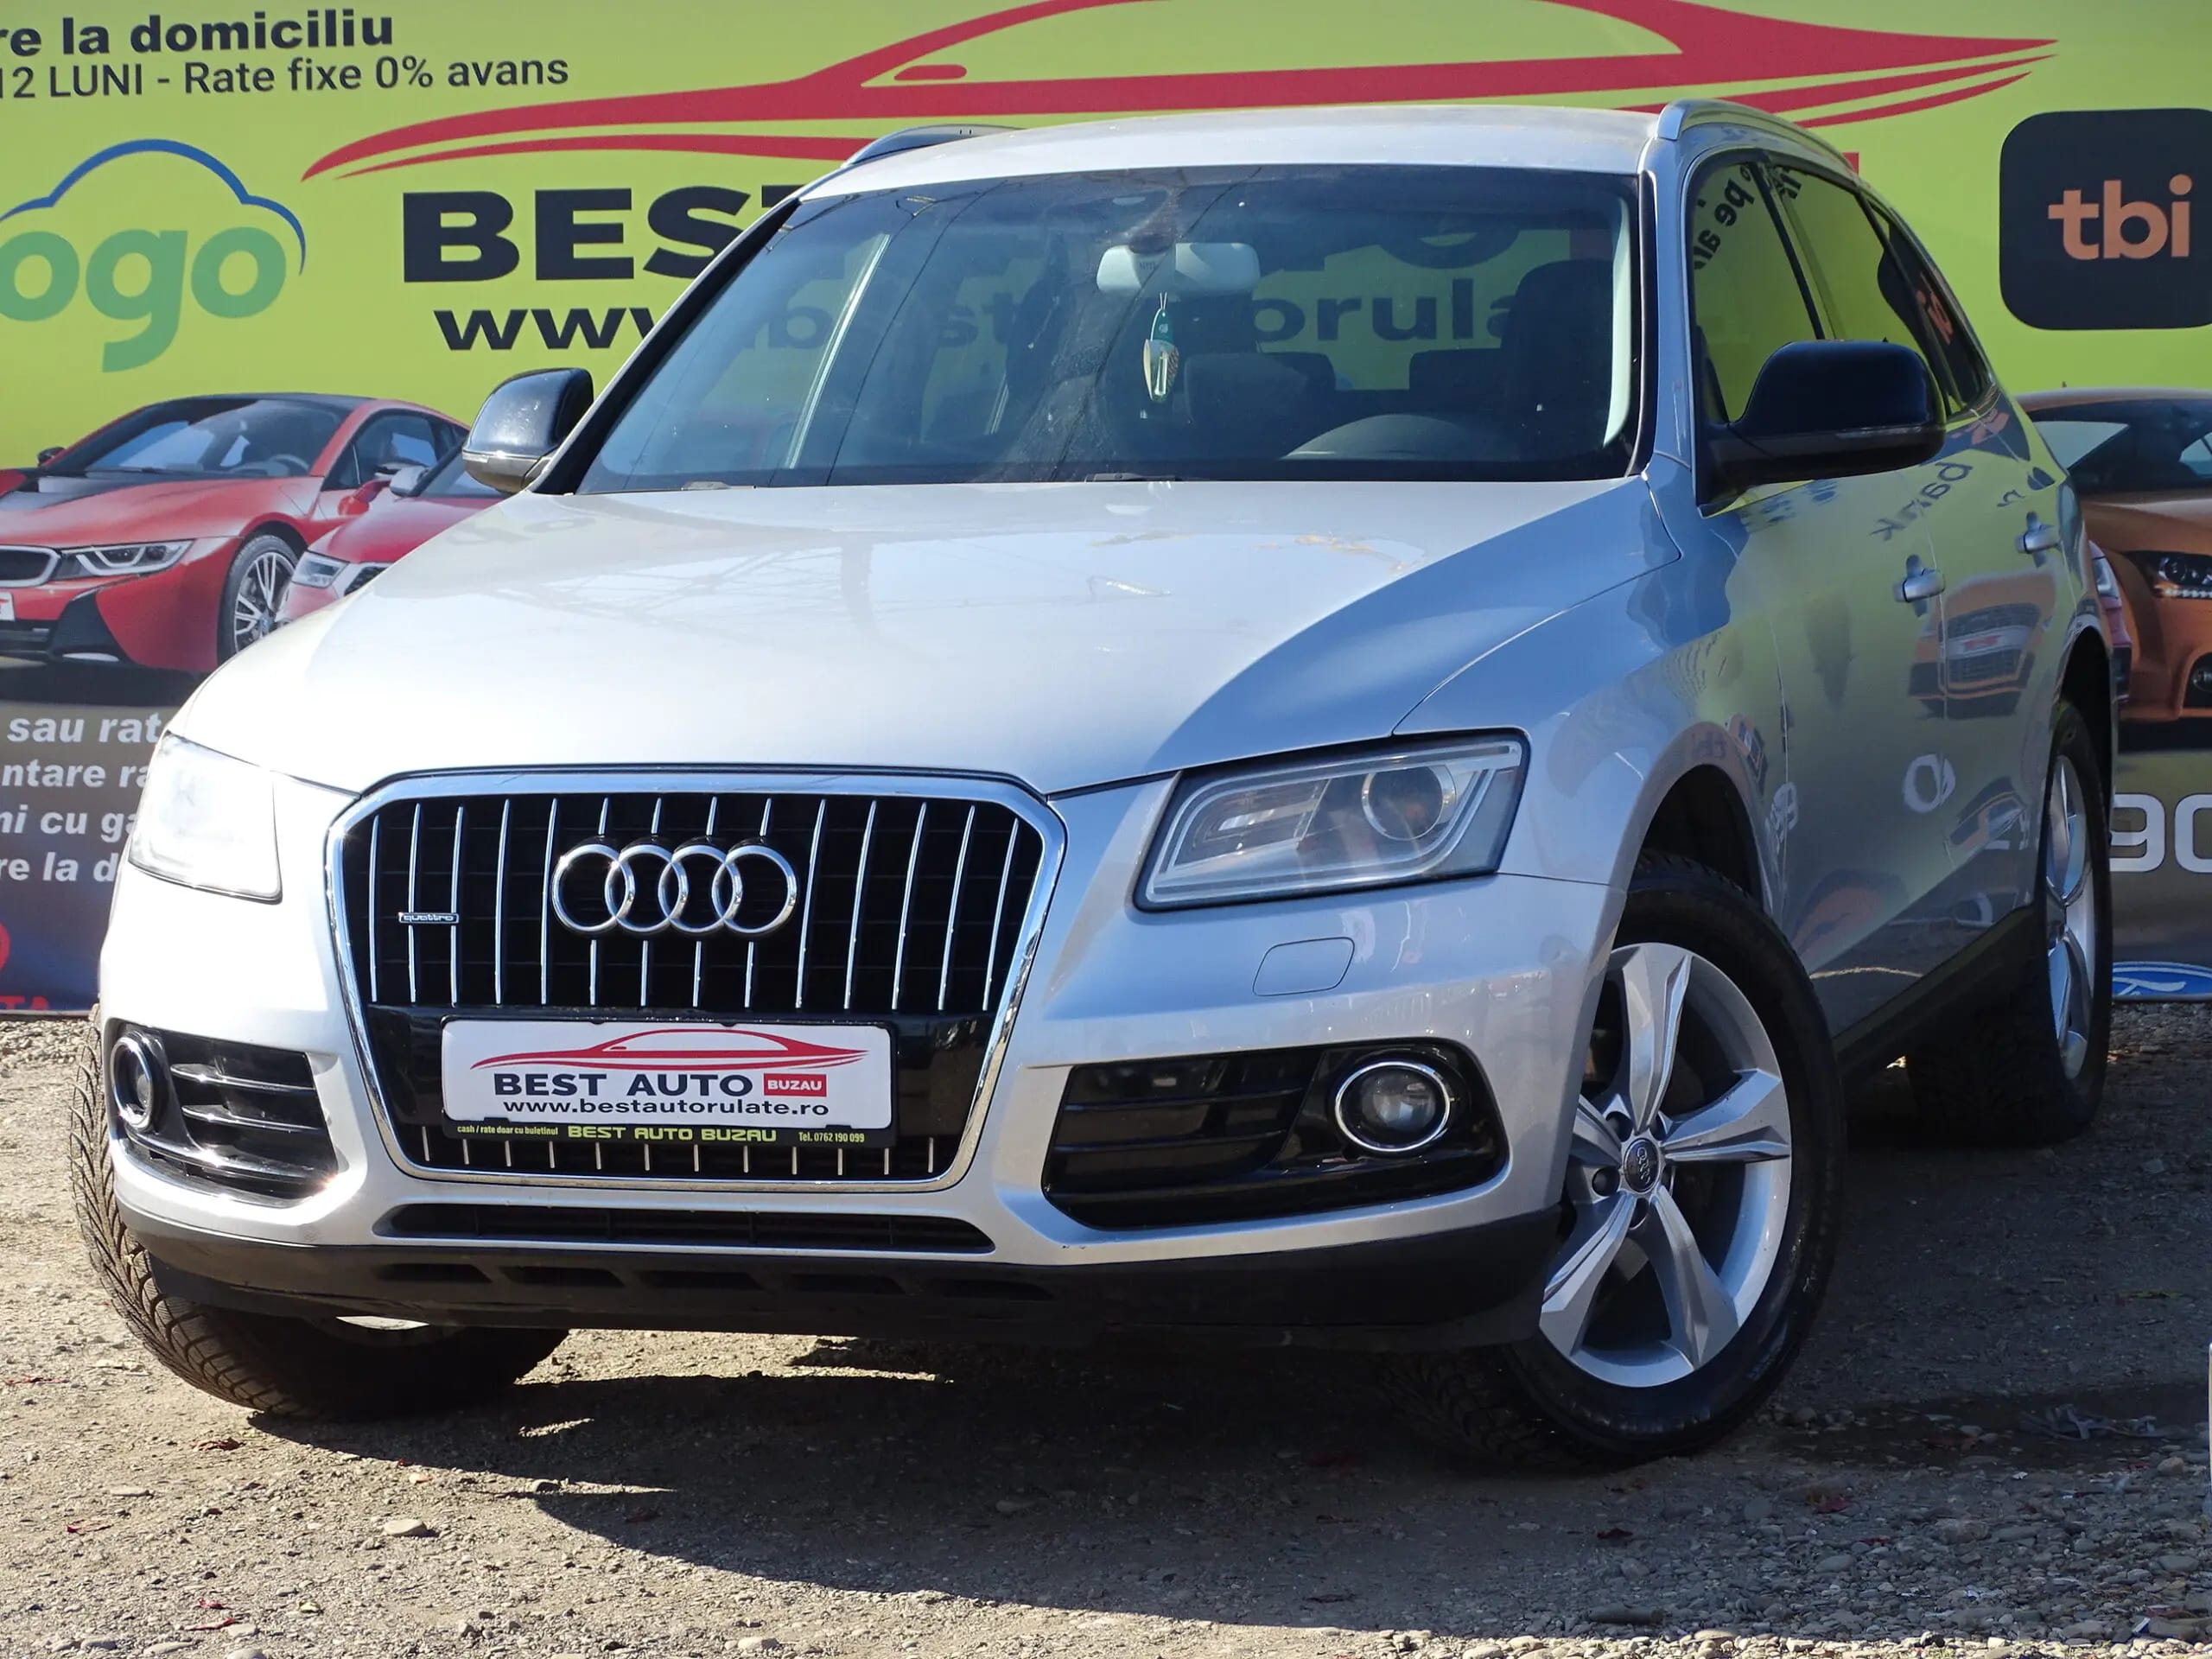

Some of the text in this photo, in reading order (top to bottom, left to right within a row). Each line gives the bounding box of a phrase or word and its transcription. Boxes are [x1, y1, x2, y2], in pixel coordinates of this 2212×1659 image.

[62, 16, 111, 55] la
[130, 9, 393, 54] domiciliu
[49, 63, 143, 97] LUNI
[184, 61, 275, 94] Rate
[288, 56, 362, 91] fixe
[375, 54, 434, 89] 0%
[447, 59, 569, 87] avans
[2048, 174, 2193, 260] tbi
[404, 185, 804, 283] BES
[7, 717, 85, 743] sau
[1, 759, 106, 788] ntare
[40, 811, 88, 835] cu
[42, 851, 79, 882] la
[404, 913, 454, 923] quattro
[493, 1073, 823, 1097] BEST AUTO BUZAU
[503, 1098, 830, 1116] www.bestautorulate.ro
[457, 1125, 475, 1134] cash
[480, 1126, 496, 1135] rate
[496, 1126, 513, 1135] doar
[524, 1126, 559, 1135] buletinul
[567, 1125, 626, 1140] BEST
[633, 1127, 693, 1141] AUTO
[700, 1128, 777, 1142] BUZAU
[798, 1131, 812, 1141] Tel.
[813, 1132, 833, 1142] 0762
[834, 1132, 849, 1142] 190
[849, 1133, 865, 1143] 099
